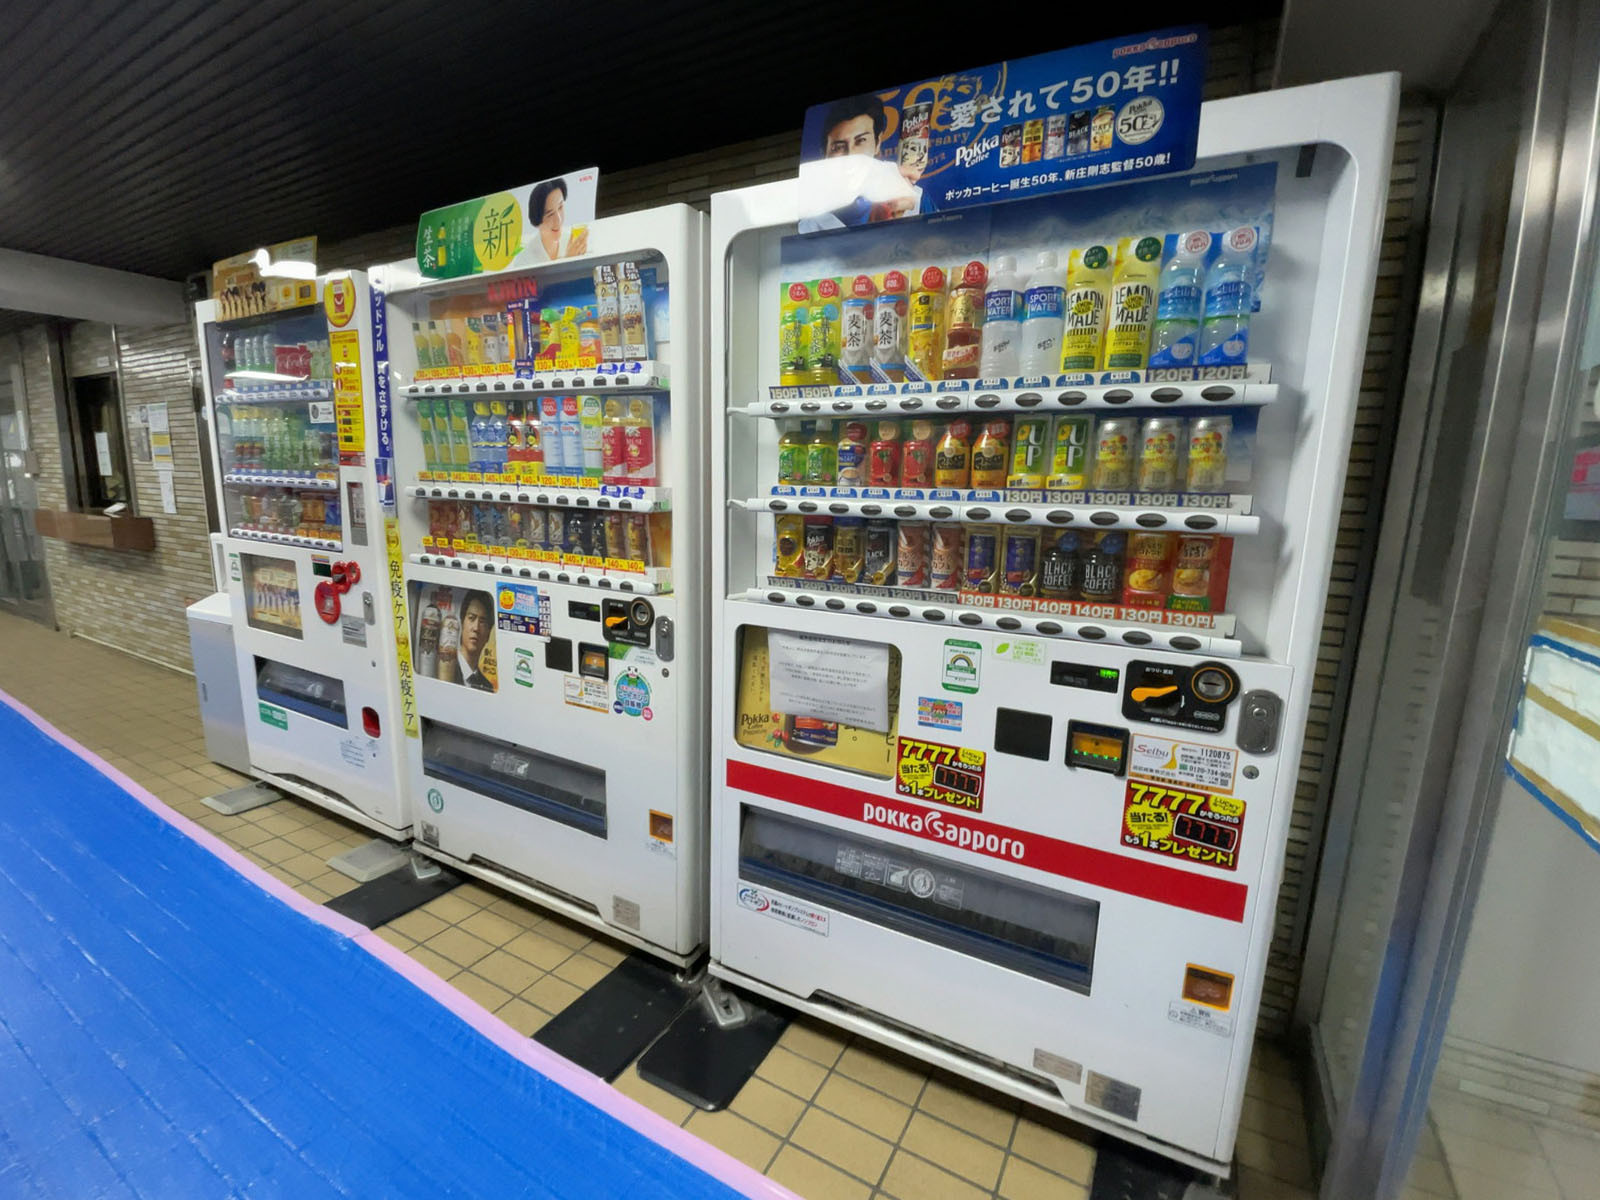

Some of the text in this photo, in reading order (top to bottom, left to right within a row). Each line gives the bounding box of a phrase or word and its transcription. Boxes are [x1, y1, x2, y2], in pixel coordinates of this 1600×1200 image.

[950, 59, 1180, 132] 愛されて50年!!
[955, 134, 1000, 167] Pokka
[423, 225, 435, 268] 生茶
[481, 207, 514, 260] 新
[1067, 291, 1104, 312] LEMON
[1116, 285, 1154, 305] LEMON
[374, 286, 385, 352] ッドブル
[879, 311, 893, 345] 麦茶
[1068, 309, 1100, 327] MADE
[1116, 305, 1149, 323] MADE
[847, 313, 861, 347] 麦茶
[1149, 365, 1245, 381] 120円 120円
[1005, 491, 1229, 507] 130円 130円 130円 130円 130円
[390, 560, 405, 630] 免疫ケア
[961, 594, 994, 607] 130円
[1034, 600, 1071, 615] 140円
[1075, 603, 1115, 617] 140円
[1120, 608, 1162, 623] 130円
[1166, 612, 1211, 628] 130円
[400, 660, 414, 726] 免疫ケア
[741, 713, 770, 726] Pokka
[901, 739, 955, 765] 7777
[901, 764, 930, 774] 当たる!
[1131, 783, 1205, 814] 7777
[1130, 812, 1169, 823] 当たる!
